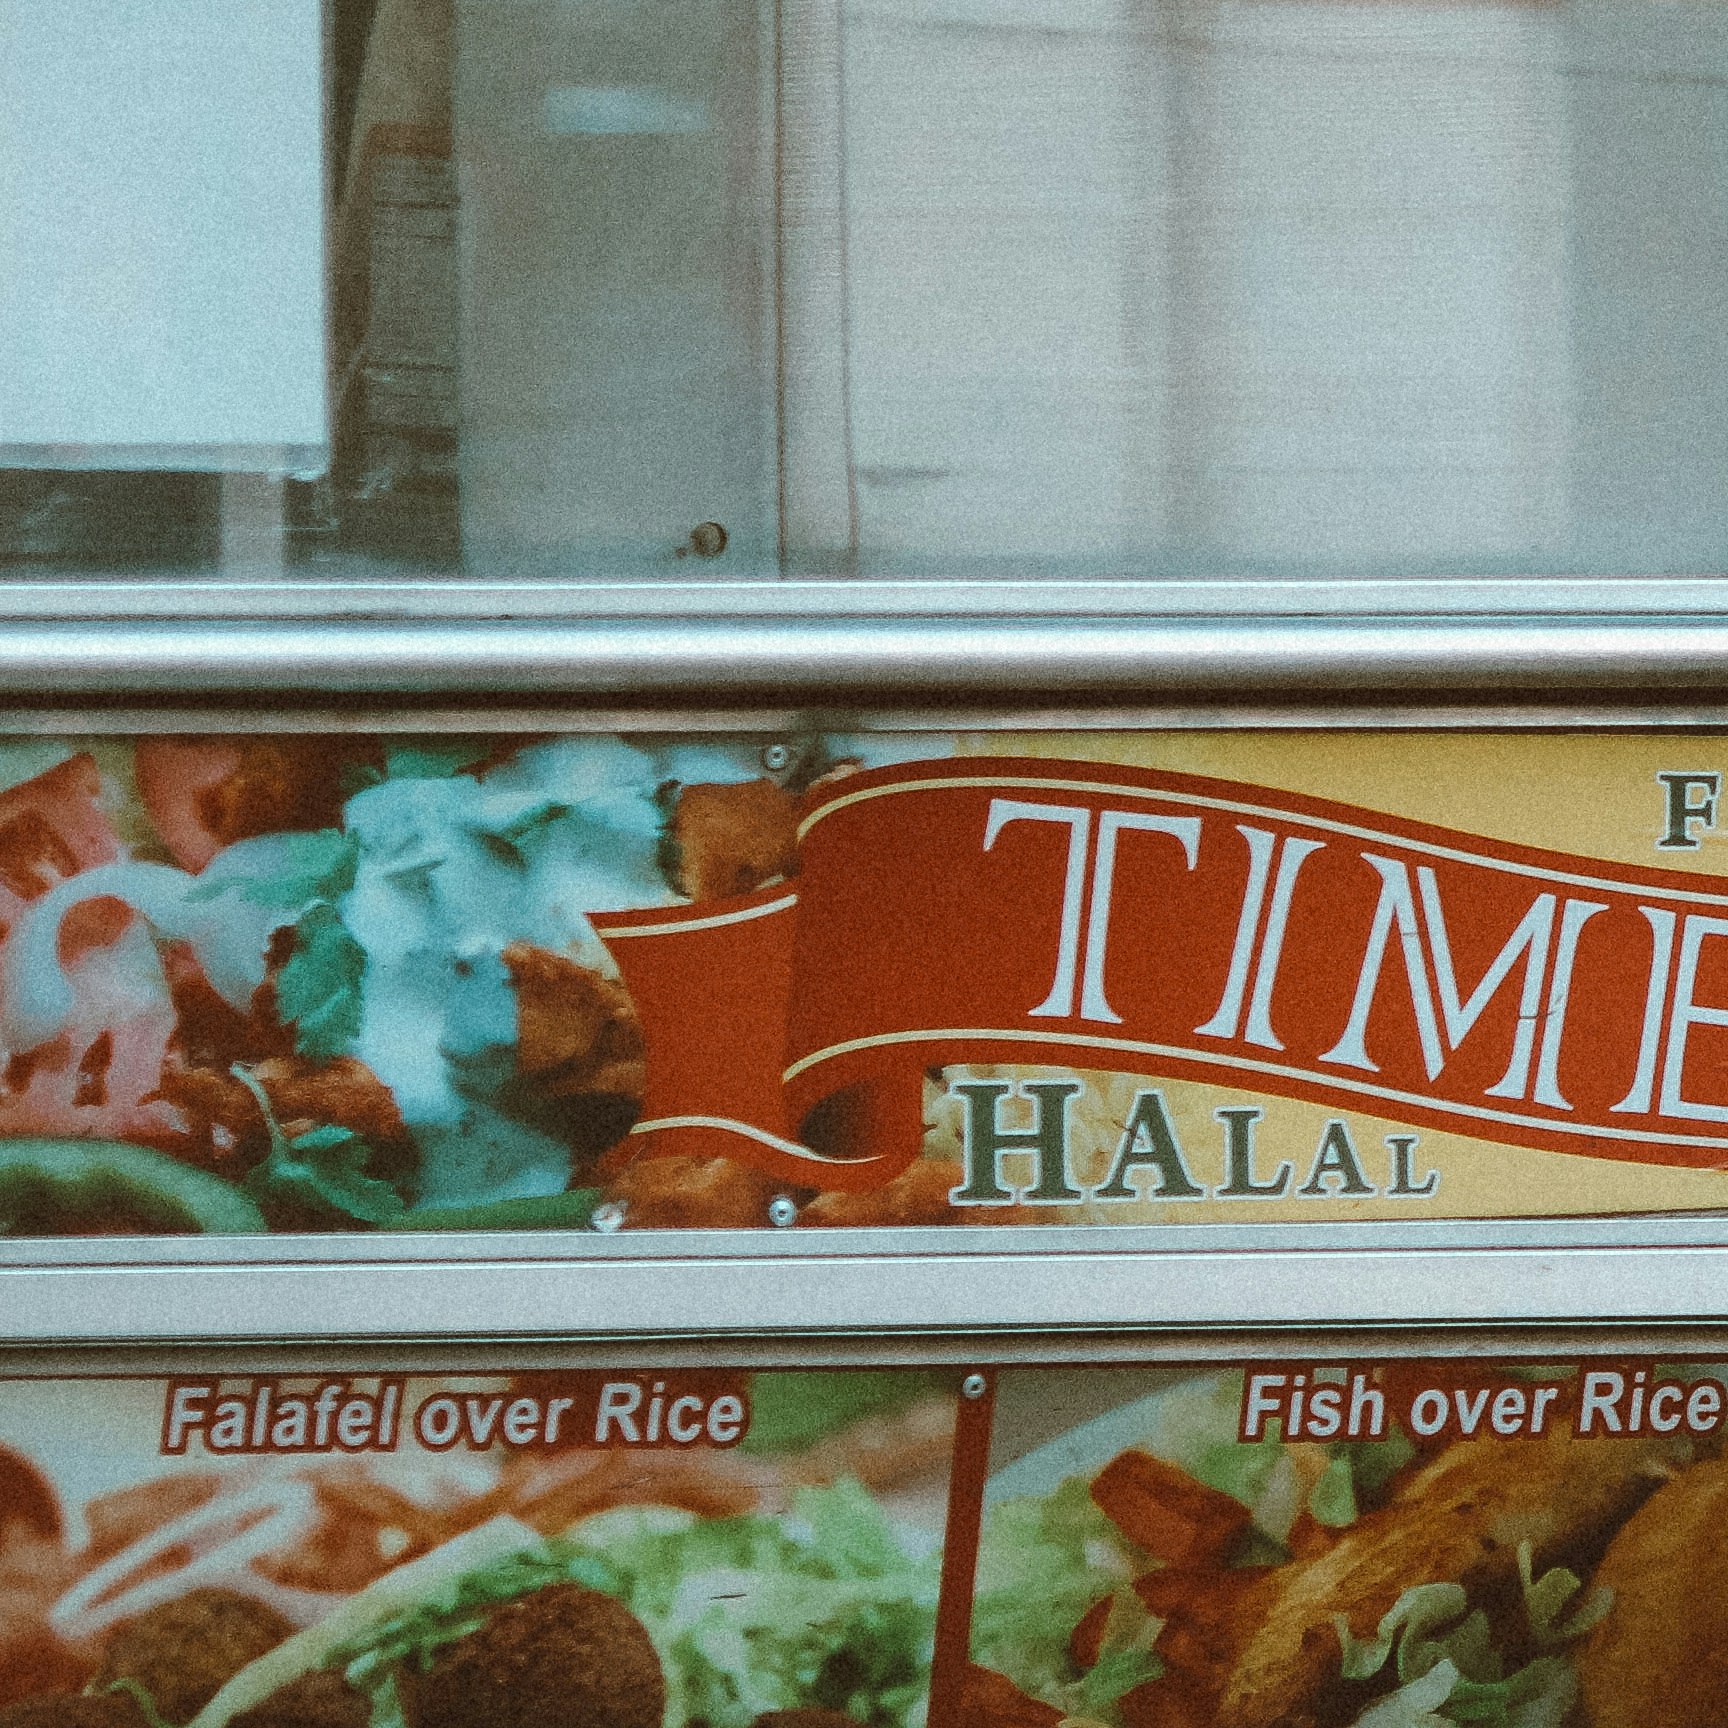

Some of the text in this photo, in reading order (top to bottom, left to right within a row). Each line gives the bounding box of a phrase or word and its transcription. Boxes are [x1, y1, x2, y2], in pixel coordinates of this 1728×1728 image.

[947, 1075, 1441, 1209] HALAL
[165, 1380, 746, 1450] Falafel over Rice
[1243, 1369, 1723, 1438] Fish over Rice
